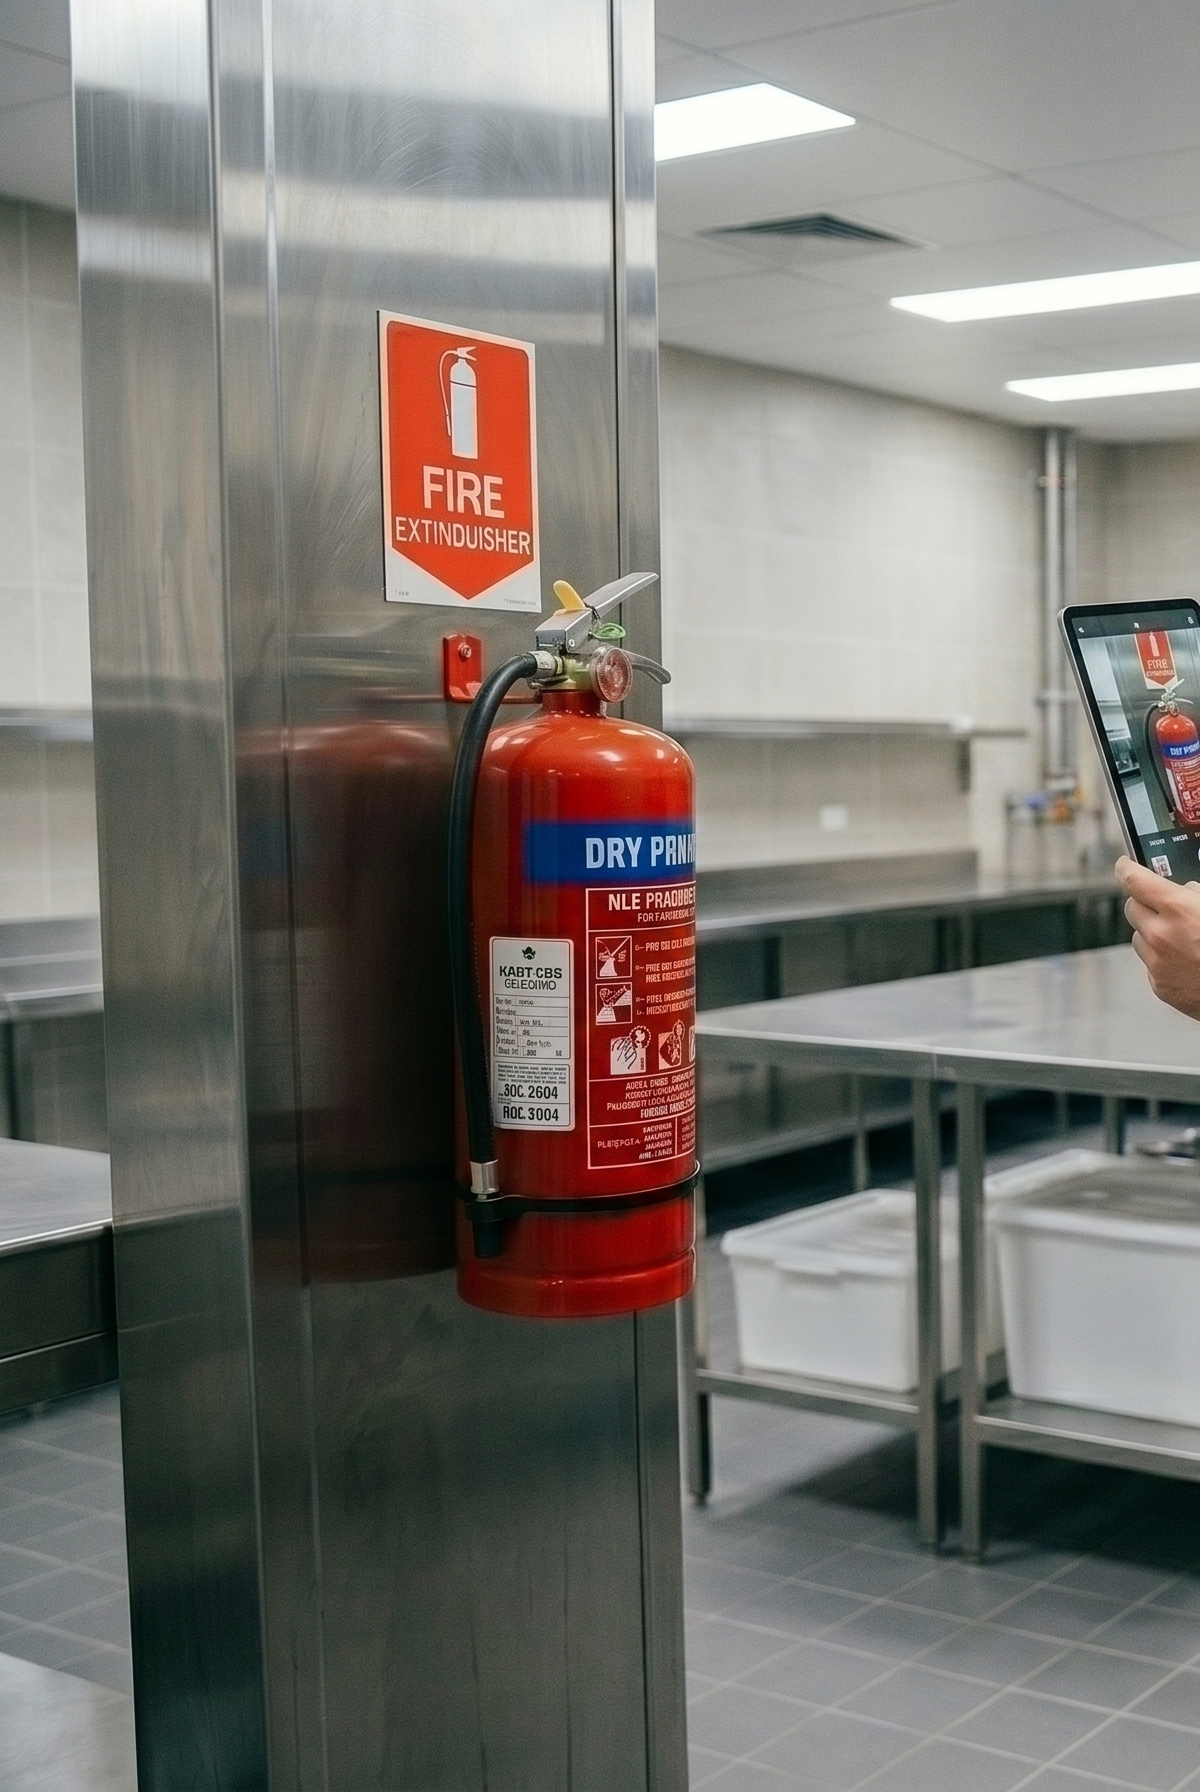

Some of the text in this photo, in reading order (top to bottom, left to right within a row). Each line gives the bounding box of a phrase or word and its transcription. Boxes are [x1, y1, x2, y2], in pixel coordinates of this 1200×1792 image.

[422, 465, 505, 519] FIRE
[585, 836, 643, 869] DRY
[608, 892, 641, 911] NLE
[528, 1085, 559, 1099] 2604
[528, 1107, 559, 1121] 3004
